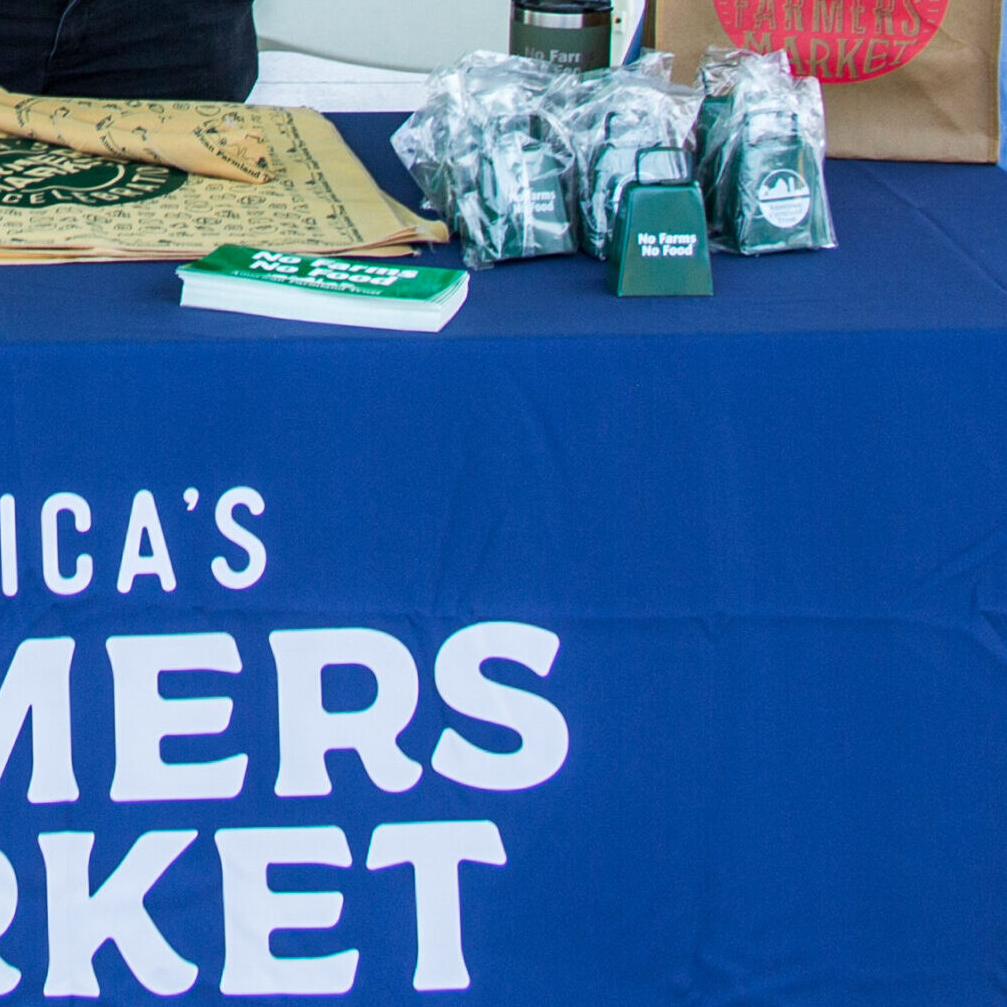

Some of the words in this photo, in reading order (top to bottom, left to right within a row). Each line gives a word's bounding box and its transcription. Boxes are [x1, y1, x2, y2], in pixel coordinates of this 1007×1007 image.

[742, 30, 919, 79] MARKET
[638, 233, 655, 245] No
[659, 233, 697, 245] Farms
[641, 245, 659, 257] No
[663, 244, 694, 257] Food
[249, 260, 299, 274] No
[308, 268, 394, 287] Food
[252, 251, 301, 264] No
[310, 258, 418, 279] Farms
